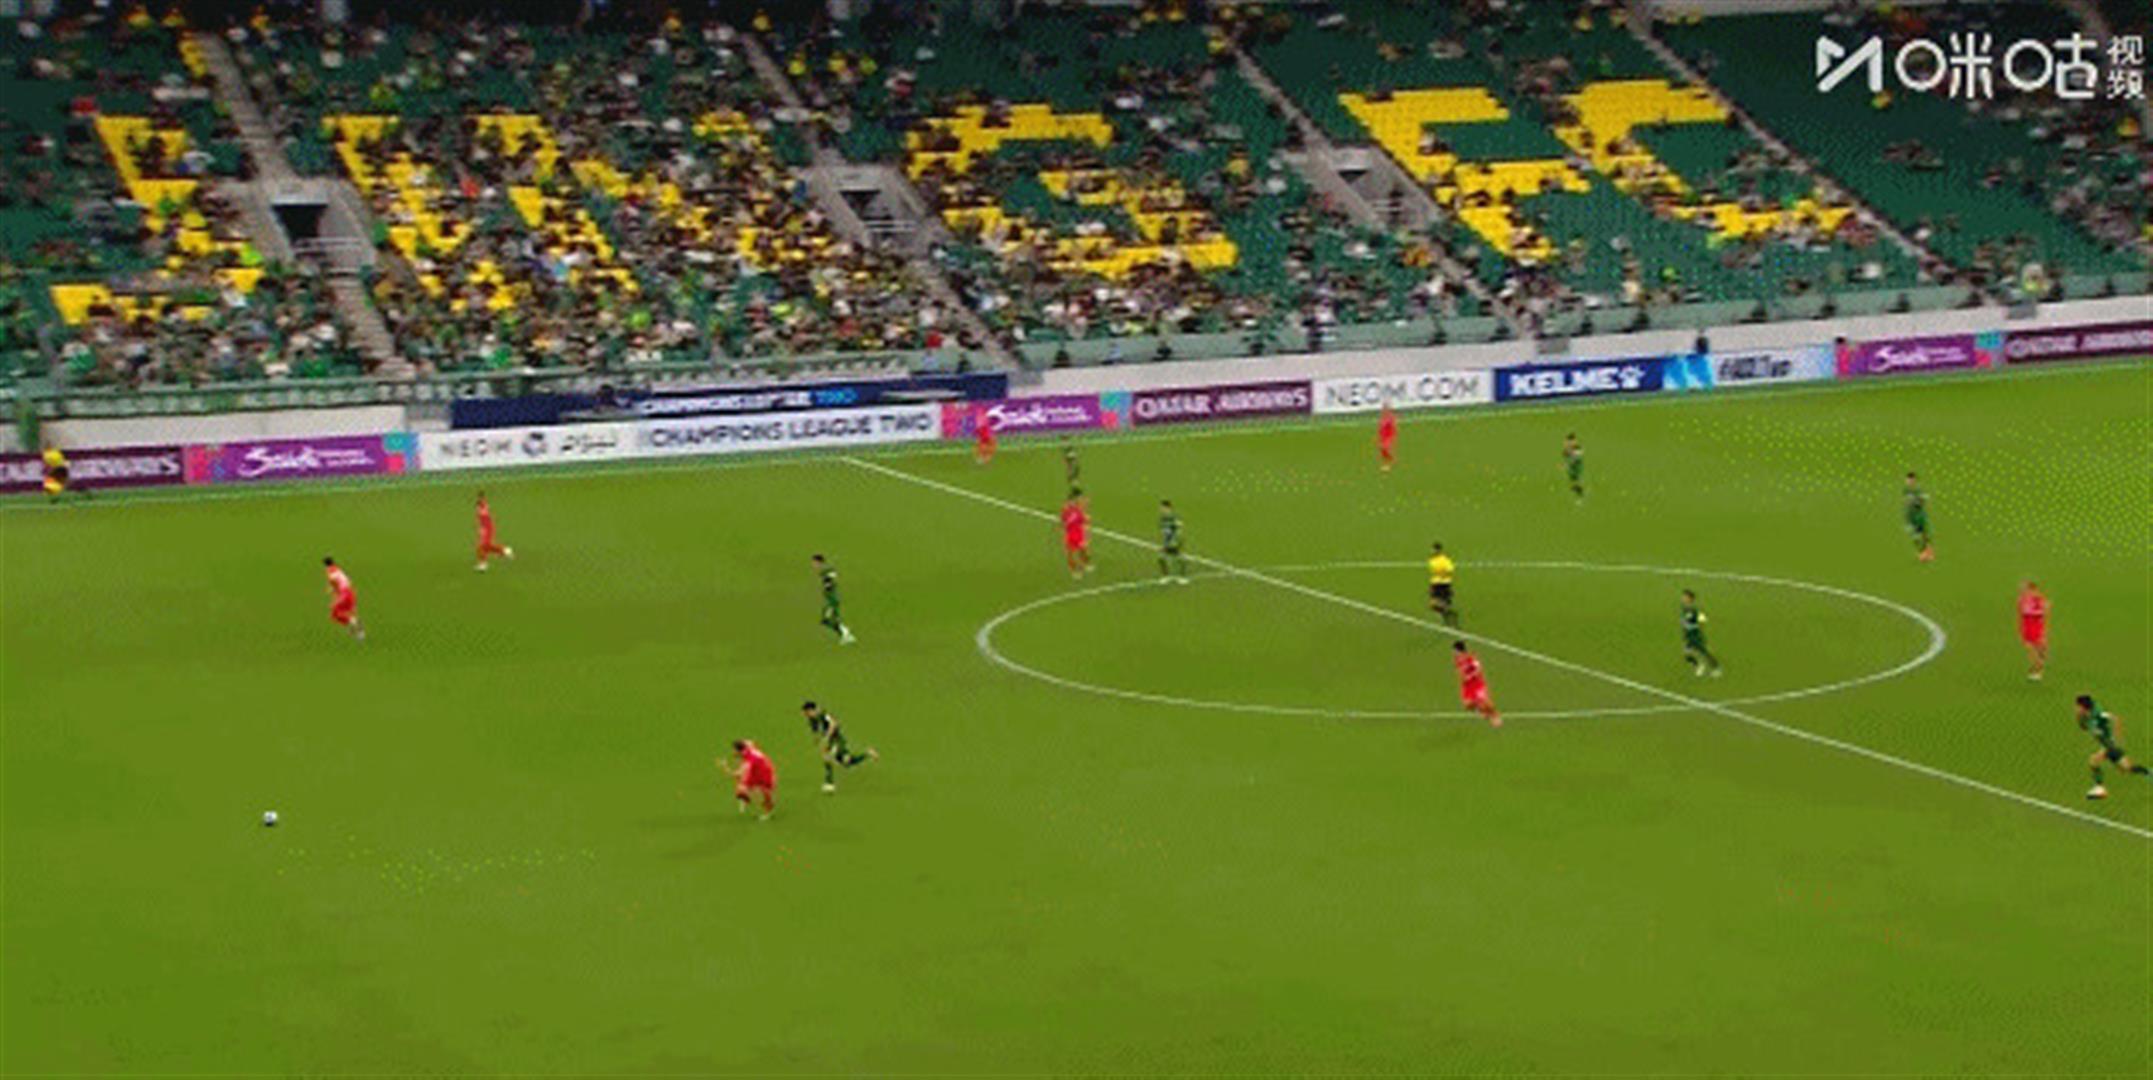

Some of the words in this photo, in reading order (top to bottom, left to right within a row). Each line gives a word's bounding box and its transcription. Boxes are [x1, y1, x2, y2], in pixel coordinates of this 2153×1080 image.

[1327, 375, 1480, 406] NEOM.COM
[1508, 366, 1623, 396] KELME
[1134, 391, 1211, 419] QATAR
[650, 420, 784, 448] CHAMPIONS
[789, 415, 873, 441] LEAGUE
[878, 410, 933, 435] TWO
